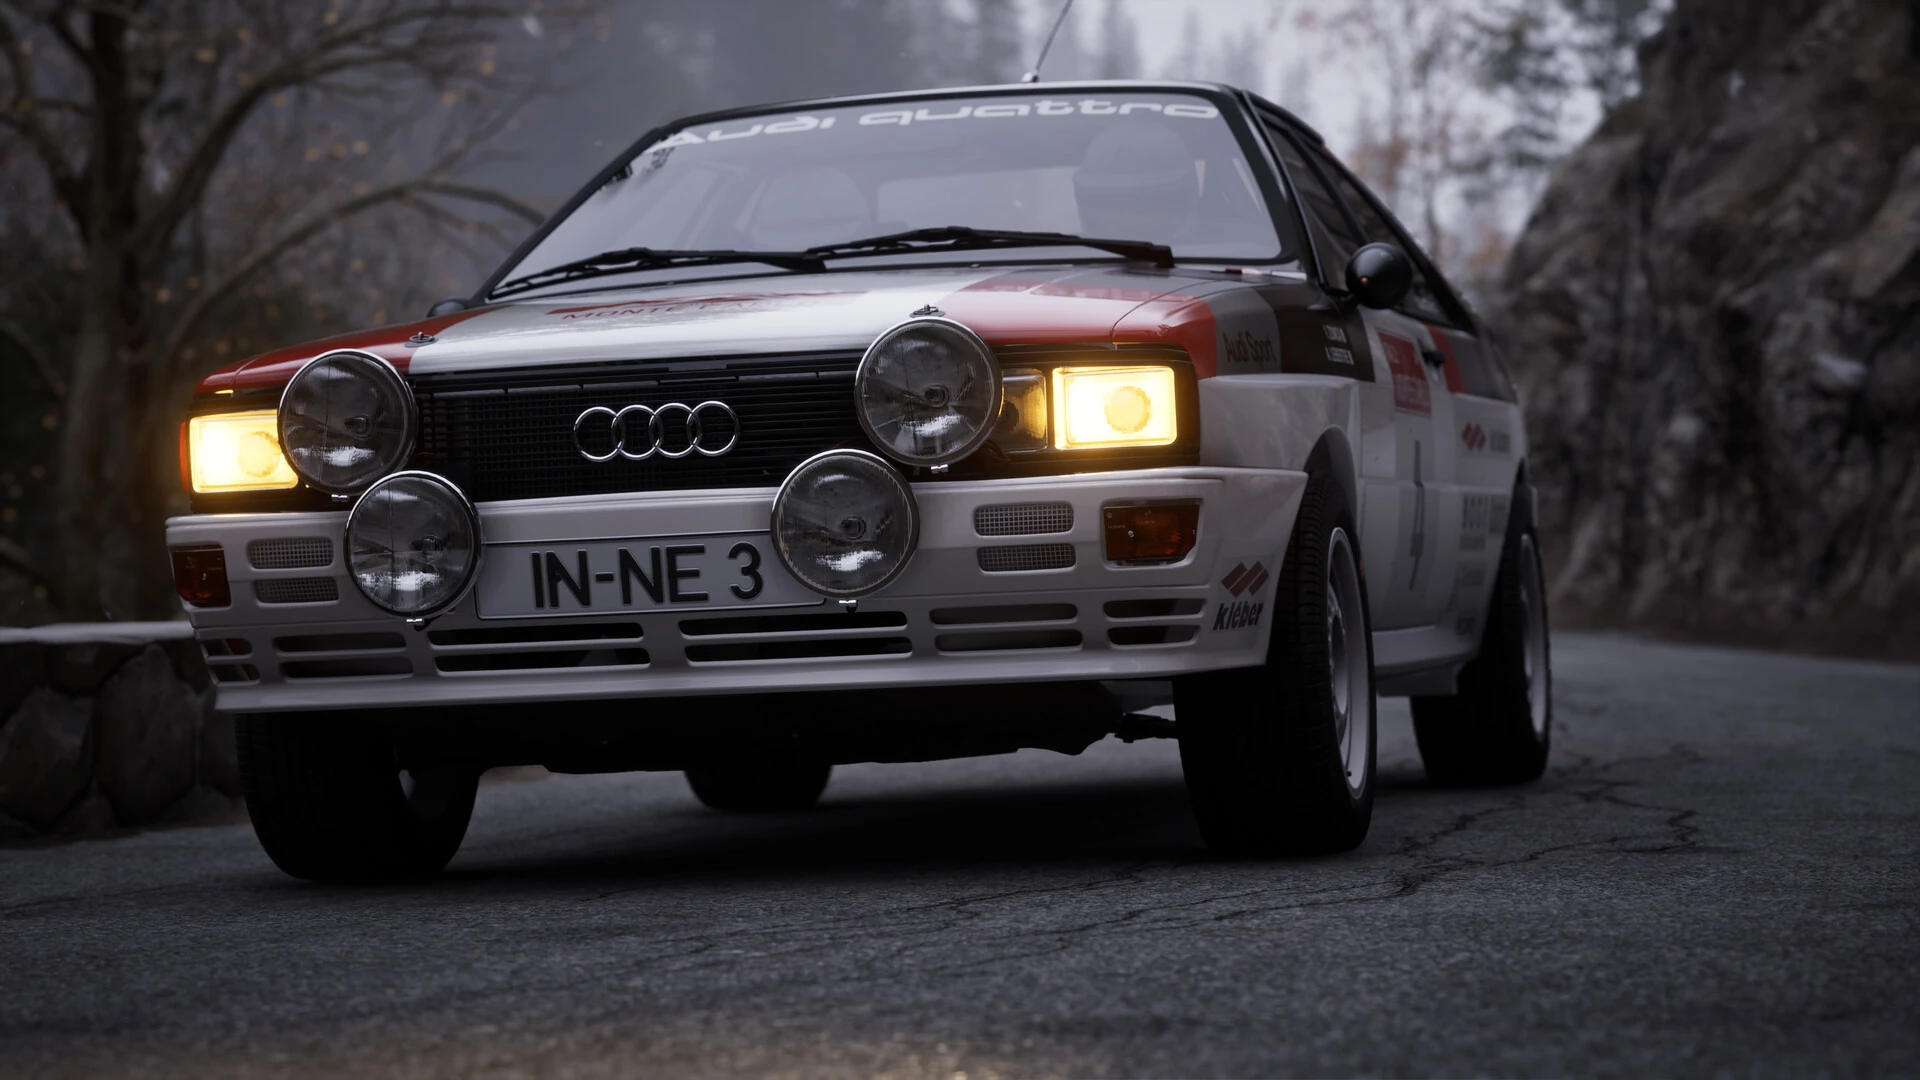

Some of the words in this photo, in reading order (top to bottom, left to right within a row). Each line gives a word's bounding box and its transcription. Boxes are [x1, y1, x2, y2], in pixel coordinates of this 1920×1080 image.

[645, 115, 836, 153] Audi
[859, 100, 1219, 126] quattro
[1222, 330, 1250, 363] Audi
[1245, 330, 1277, 371] Sport
[530, 544, 708, 609] IN-NE
[728, 541, 763, 600] 3
